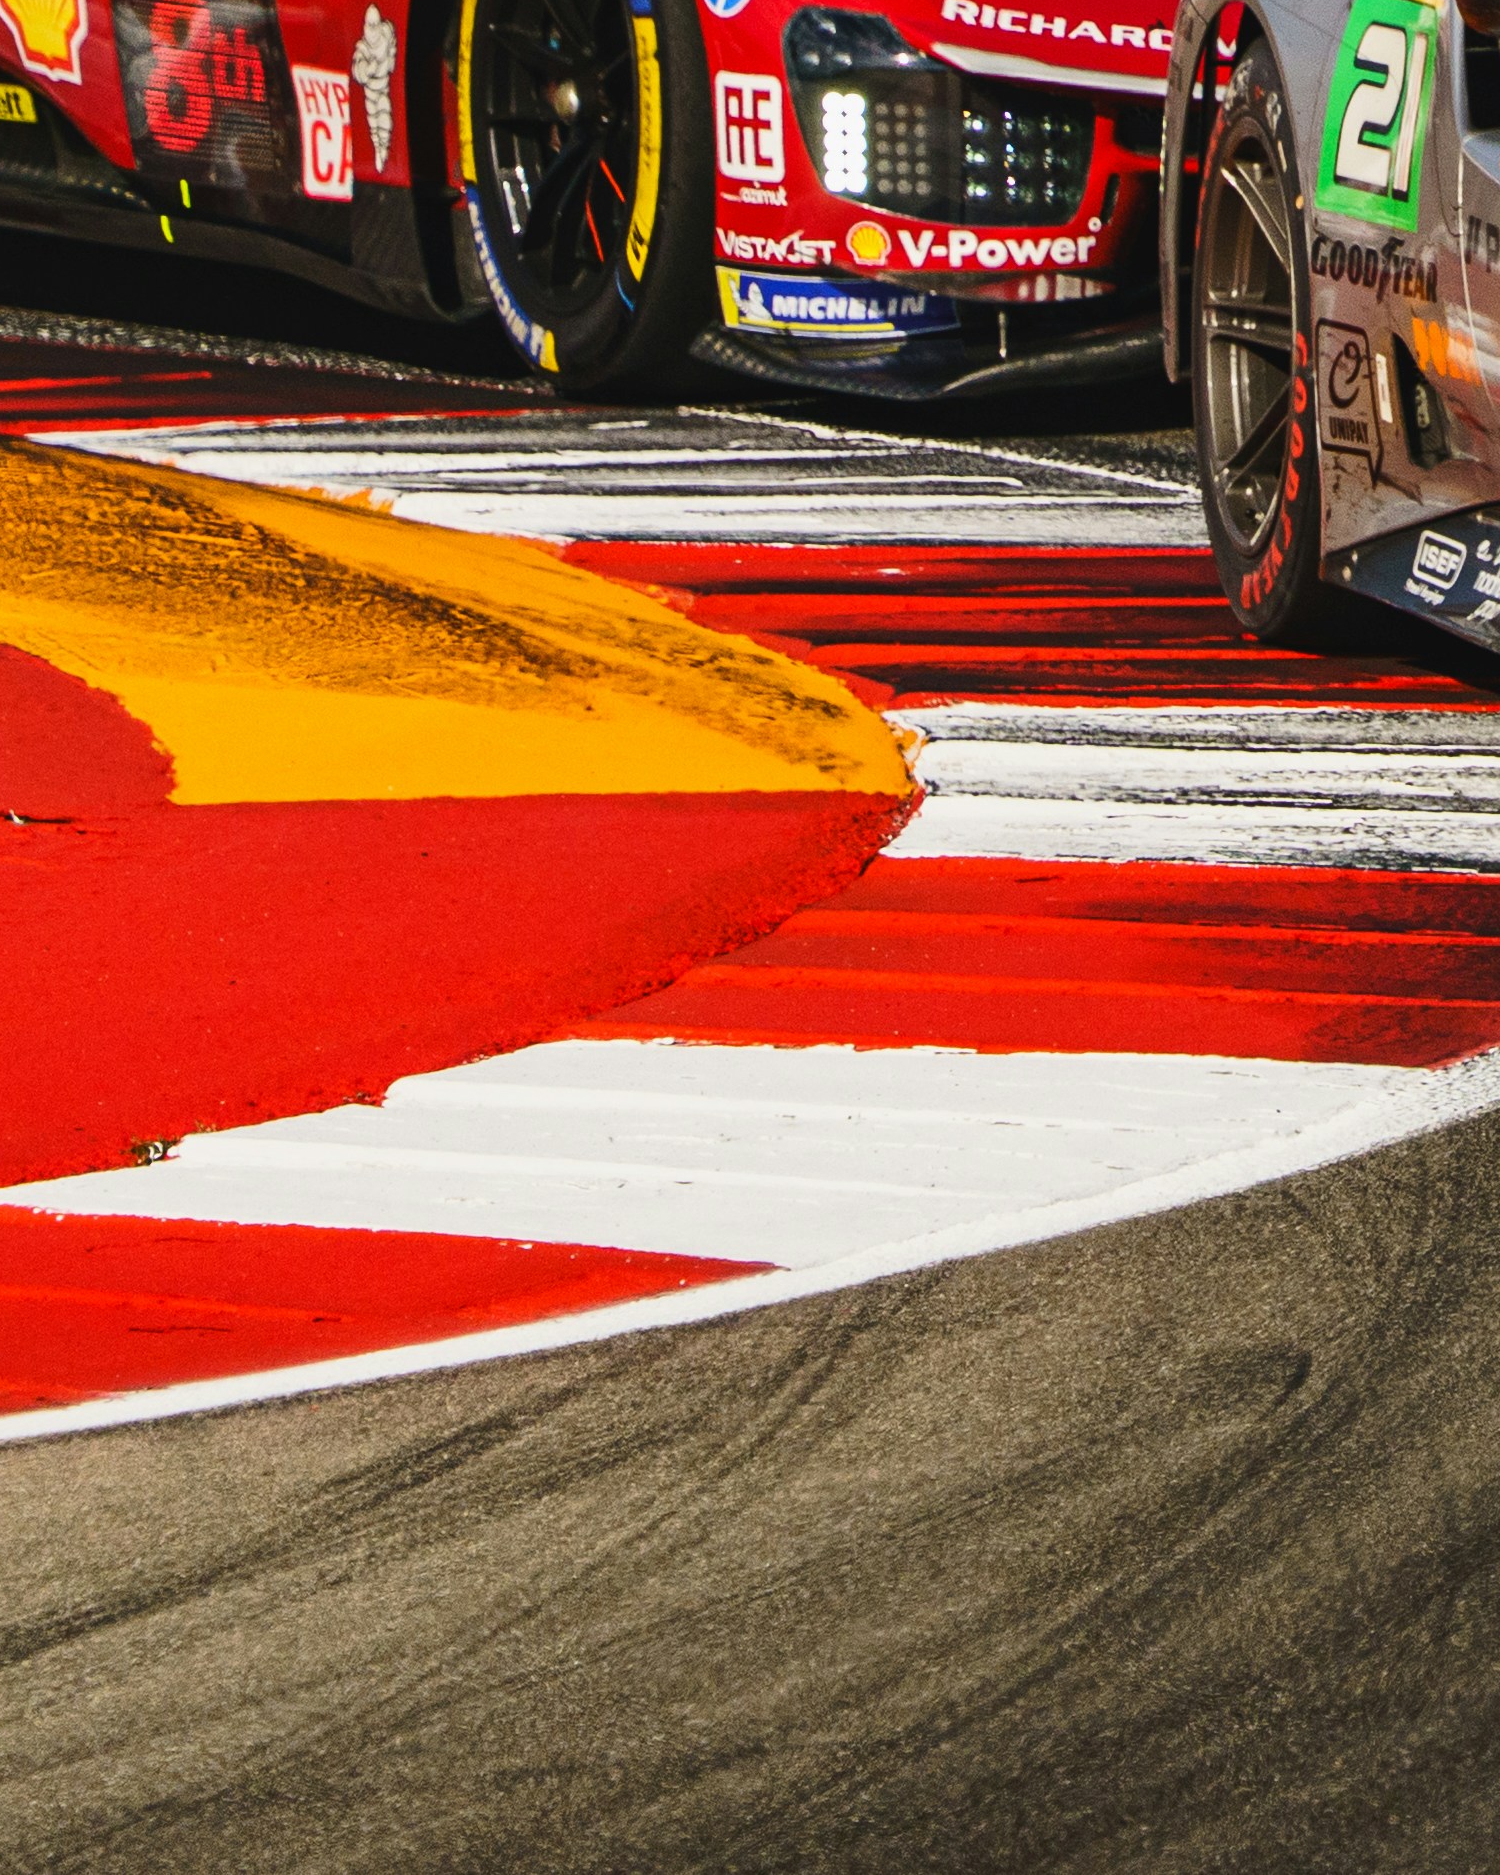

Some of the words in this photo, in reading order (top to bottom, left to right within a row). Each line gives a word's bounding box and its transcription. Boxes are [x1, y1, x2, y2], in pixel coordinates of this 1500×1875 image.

[300, 79, 350, 119] HYP
[1335, 20, 1429, 203] 21
[310, 120, 353, 185] CA
[740, 179, 788, 206] azimut
[716, 228, 837, 265] VISTAJET
[897, 228, 1097, 269] V-Power
[1310, 234, 1438, 304] GOODYEAR
[771, 293, 926, 320] MICHELIN
[1328, 415, 1369, 445] UNIPAY
[1419, 542, 1461, 577] ISEF
